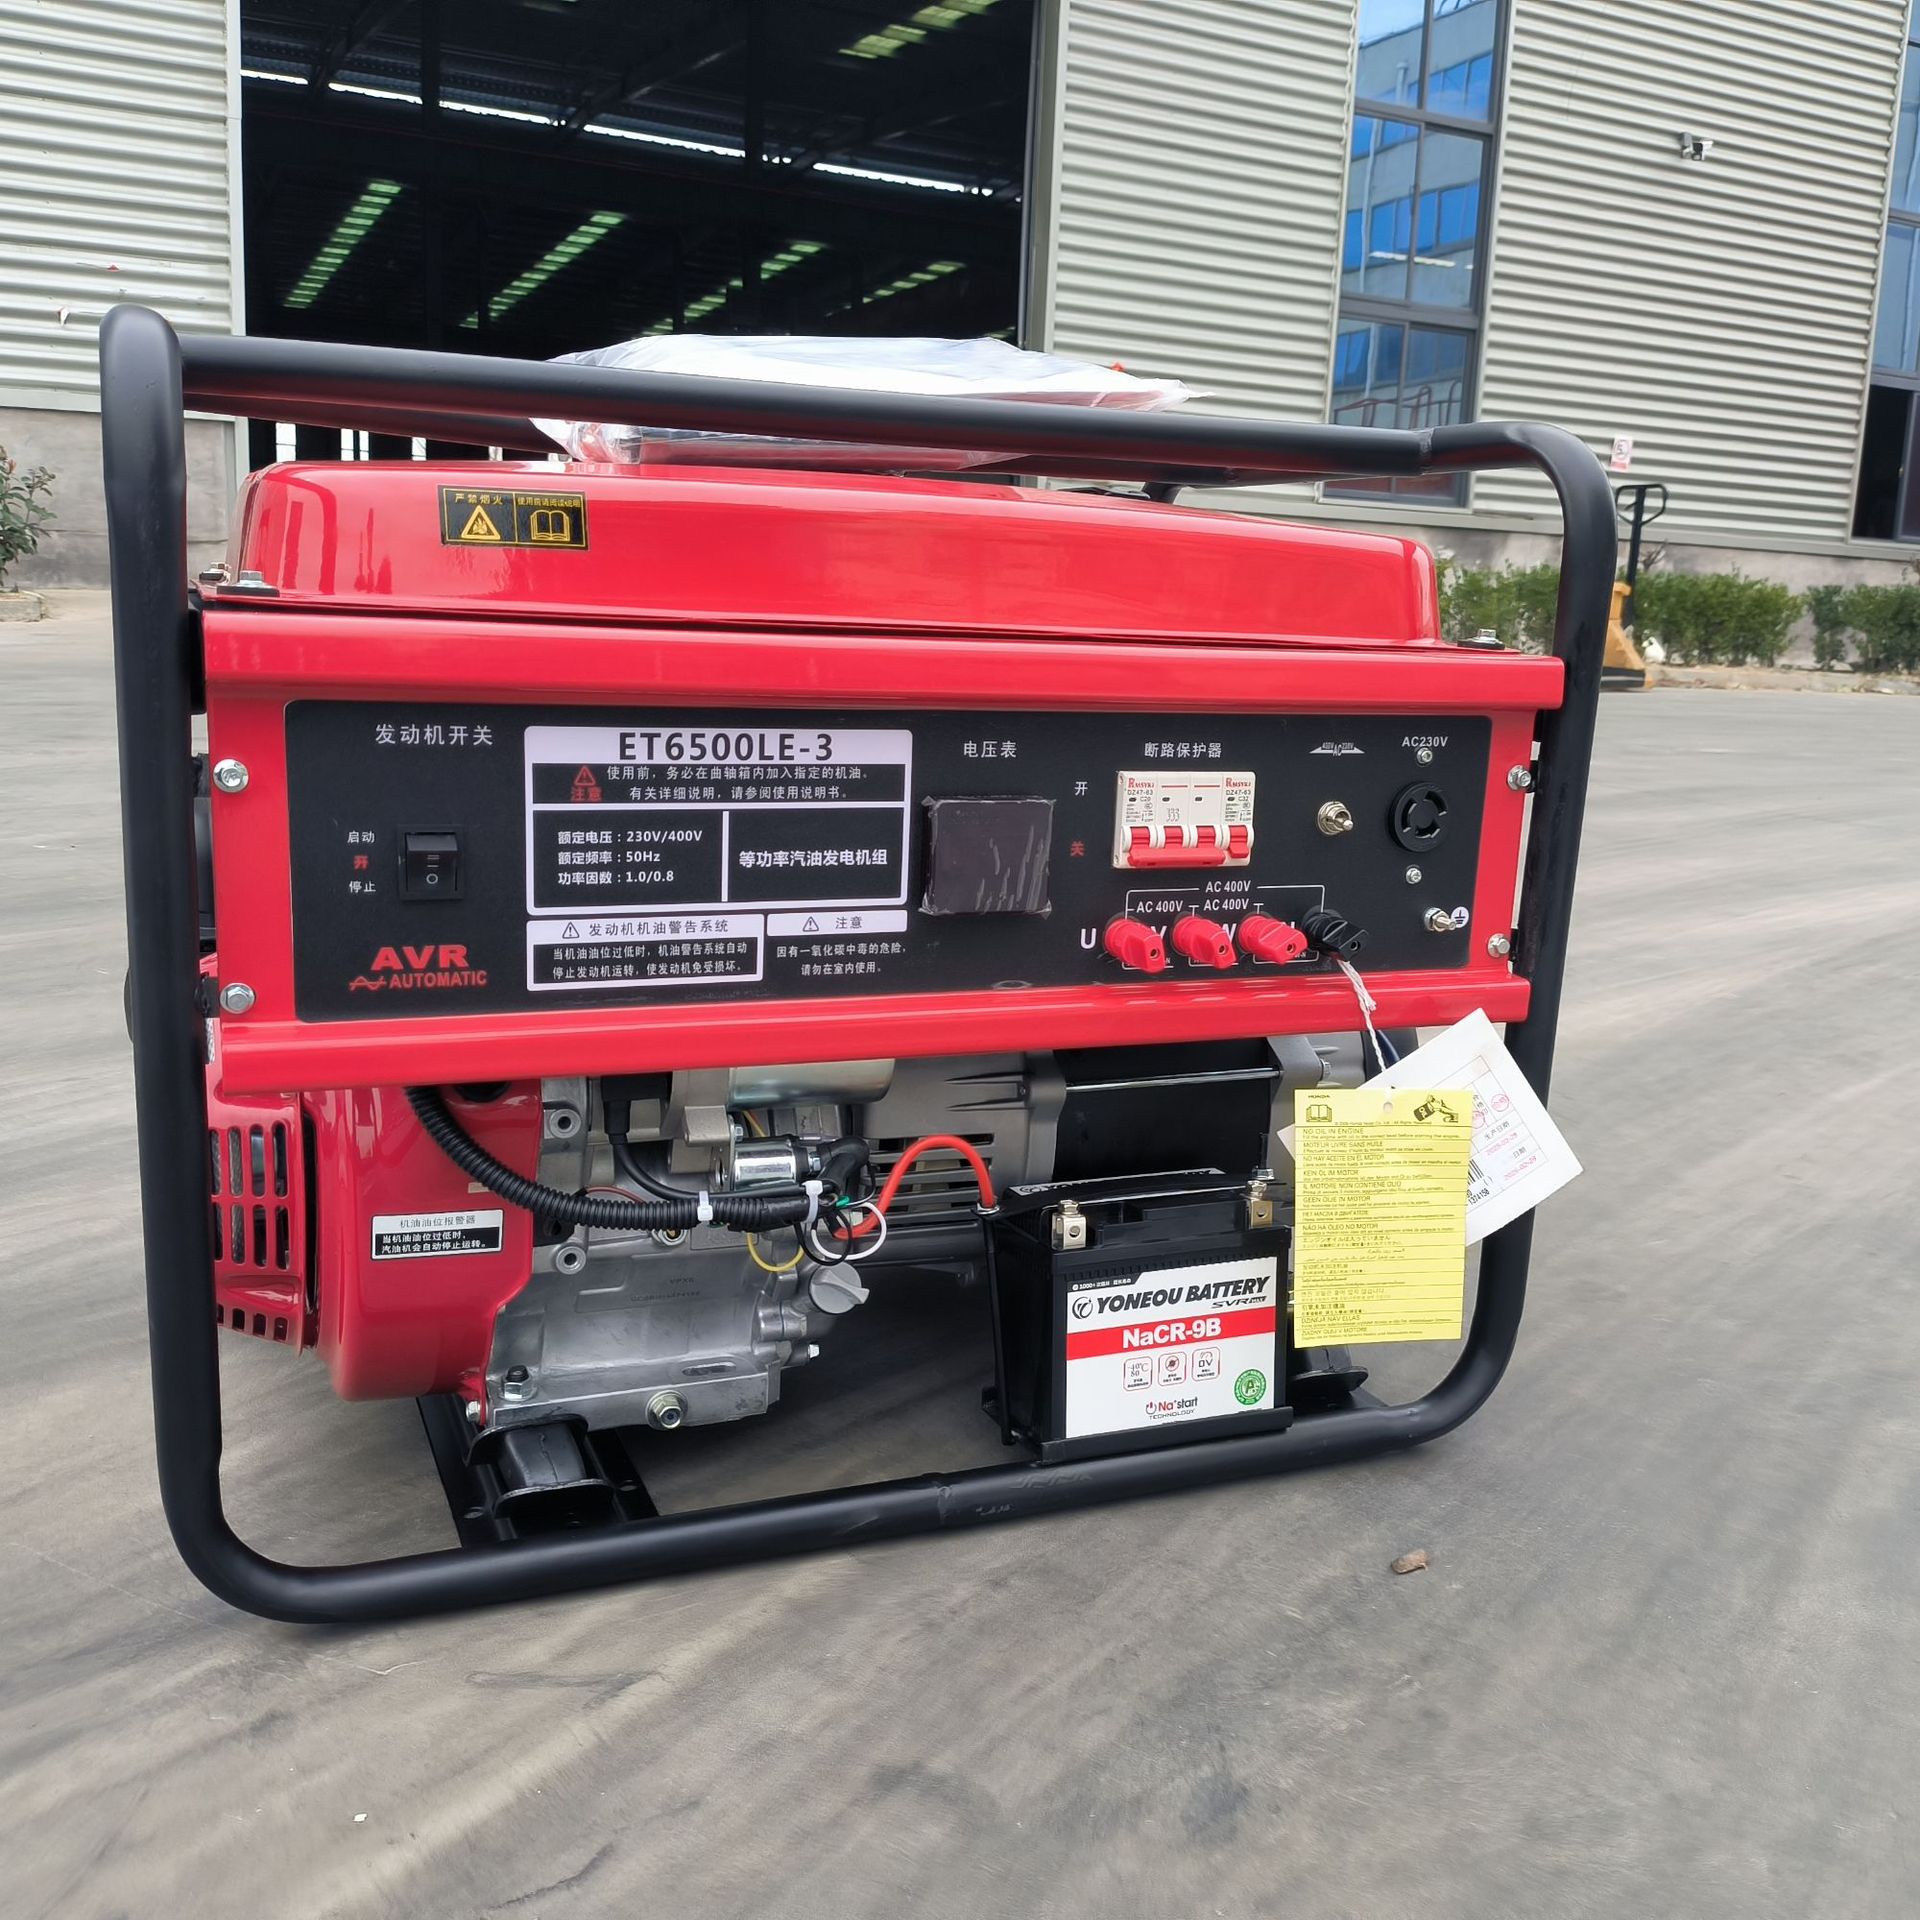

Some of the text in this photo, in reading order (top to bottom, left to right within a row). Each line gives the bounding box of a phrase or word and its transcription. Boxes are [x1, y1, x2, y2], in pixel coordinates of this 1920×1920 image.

[375, 723, 493, 746] 发动机开关
[1402, 736, 1448, 748] AC230V
[618, 731, 834, 762] ET6500LE-3
[963, 741, 1017, 758] 电压表
[1144, 742, 1222, 758] 断路保护器
[571, 786, 601, 802] 注意
[1074, 781, 1088, 796] 开
[347, 831, 375, 844] 启动
[1070, 841, 1084, 856] 关
[354, 855, 368, 870] 开
[739, 849, 888, 867] 等功率汽油发电机组
[349, 881, 376, 893] 停止
[1206, 880, 1251, 893] AC 400V
[1136, 900, 1184, 914] AC 400V
[1204, 898, 1250, 912] AC 400V
[589, 918, 729, 938] 发动机机油警告系统
[835, 916, 863, 930] 注意
[1080, 928, 1096, 950] U
[370, 945, 469, 970] AVR
[389, 971, 488, 990] AUTOMATIC
[1097, 1276, 1270, 1314] YONEOU BATTERY
[1122, 1318, 1222, 1349] NaCR-9B
[1149, 1408, 1196, 1420] TECHNOLOGY
